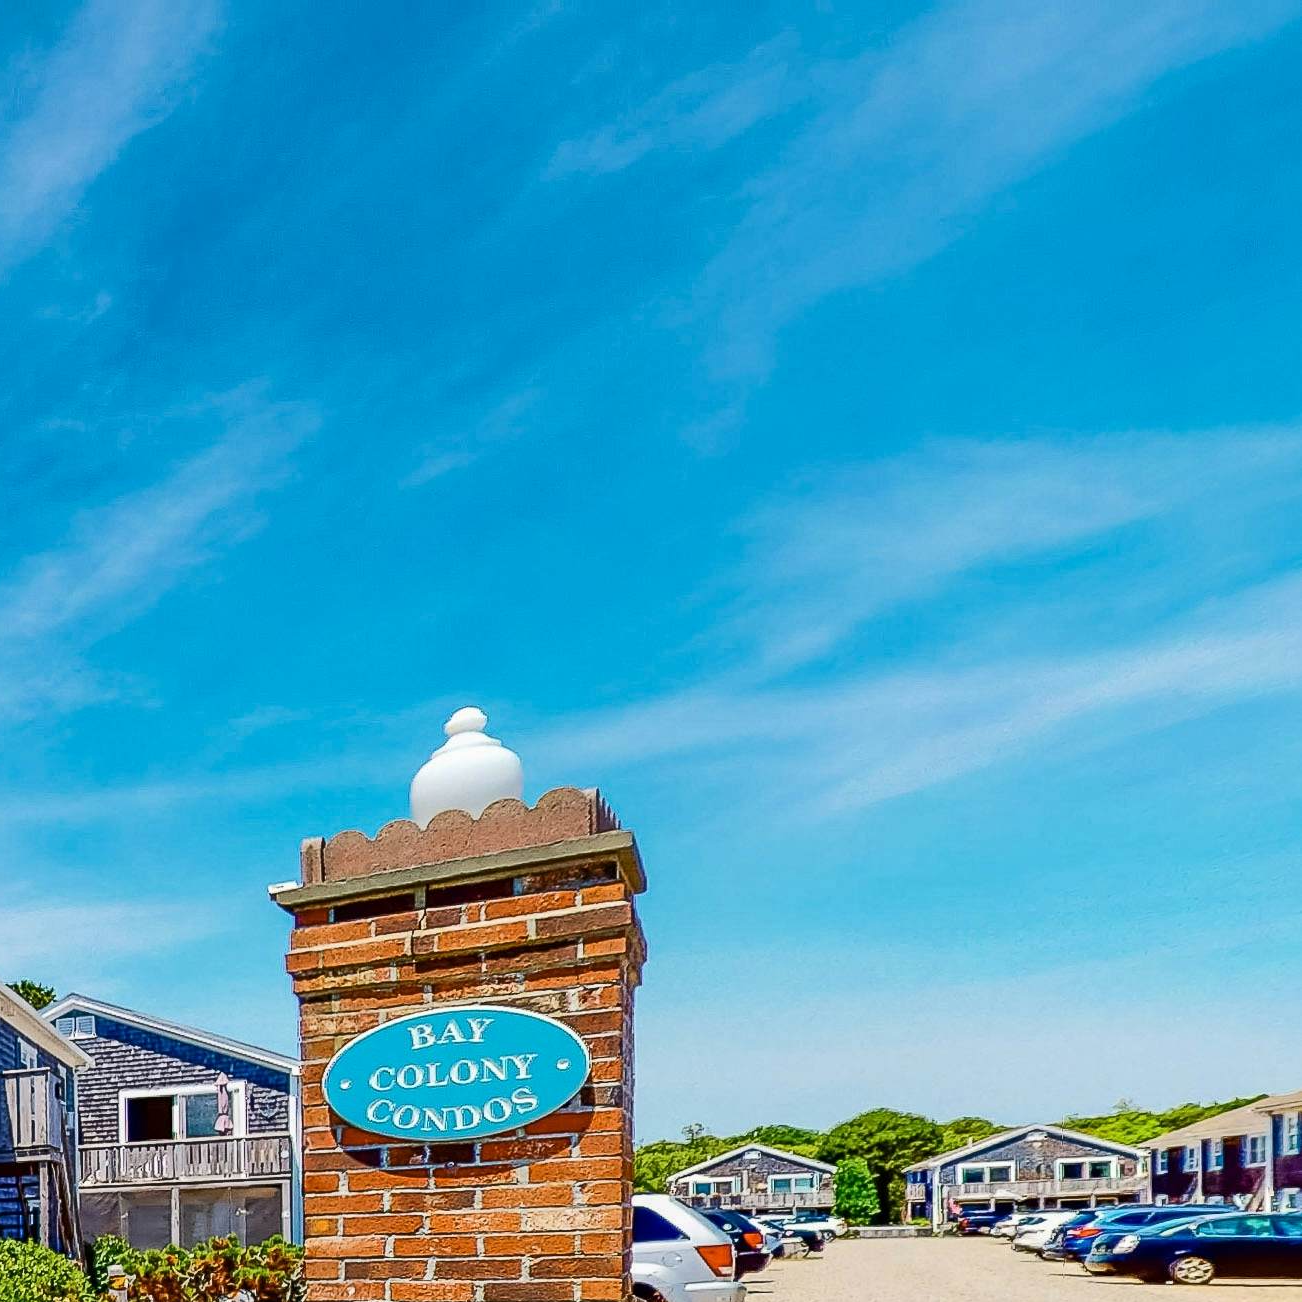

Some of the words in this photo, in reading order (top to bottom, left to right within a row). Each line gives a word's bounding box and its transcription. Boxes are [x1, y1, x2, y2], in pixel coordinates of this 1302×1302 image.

[407, 1018, 494, 1050] BAY
[368, 1053, 539, 1091] COLONY
[367, 1087, 538, 1132] CONDOS
